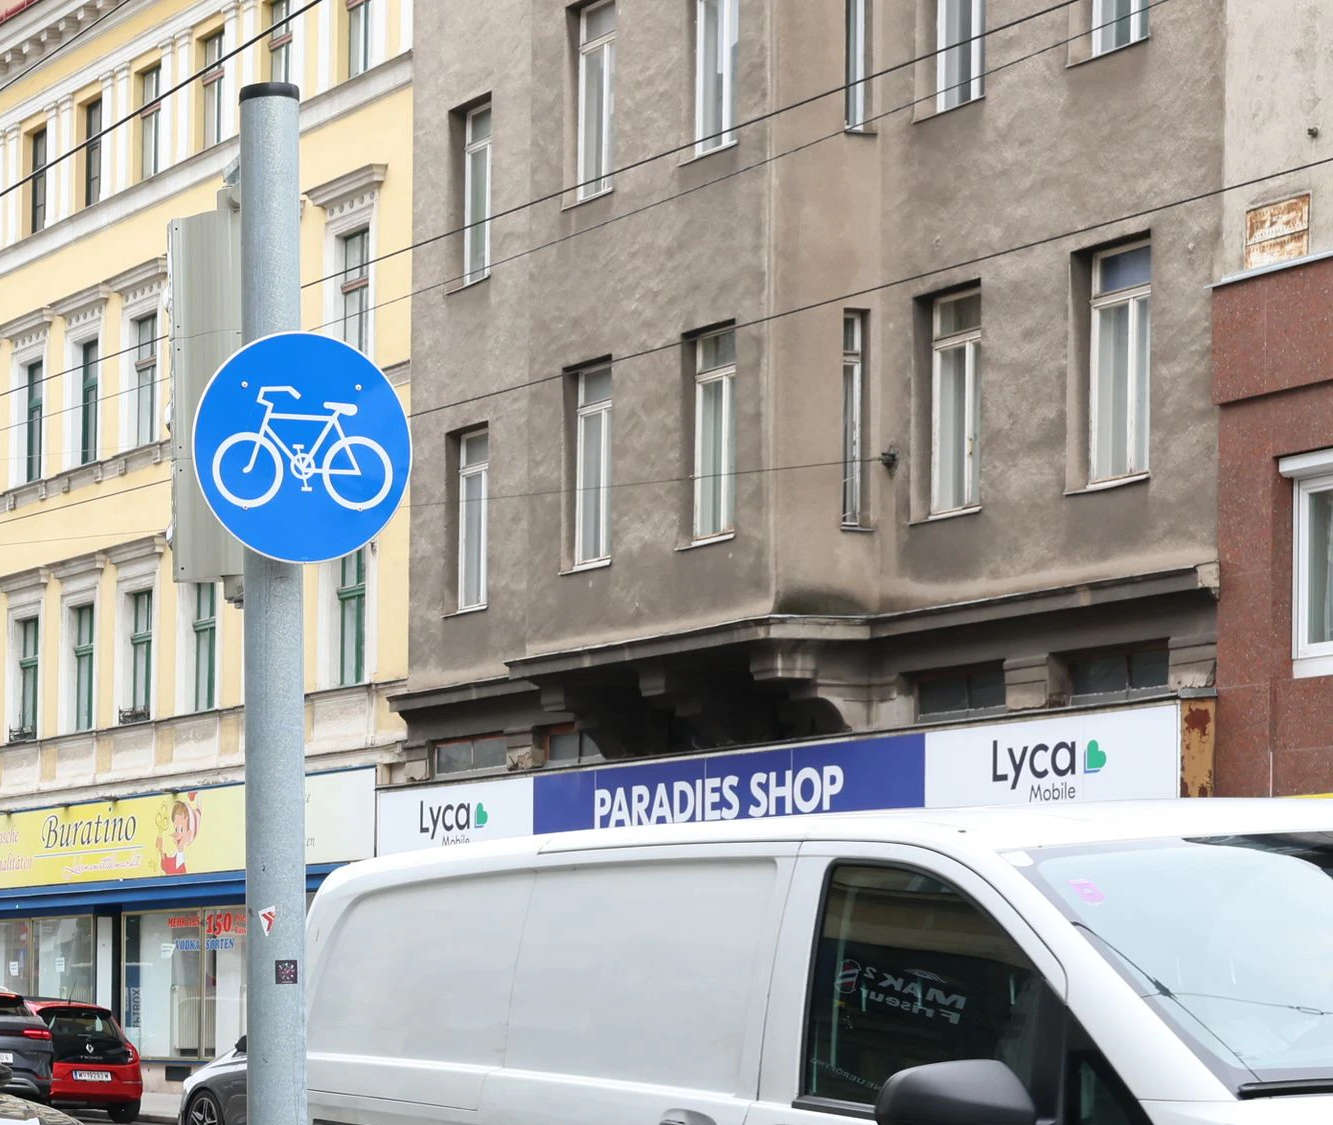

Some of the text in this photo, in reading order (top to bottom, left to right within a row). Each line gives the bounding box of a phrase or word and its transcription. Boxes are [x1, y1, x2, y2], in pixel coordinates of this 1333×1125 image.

[991, 739, 1077, 791] Lyca
[594, 765, 845, 829] PARADIES SHOP
[1029, 782, 1077, 803] Mobile
[42, 806, 137, 849] Buratino
[419, 800, 471, 840] Lyca
[205, 912, 232, 935] 150
[205, 938, 234, 950] SORTEN
